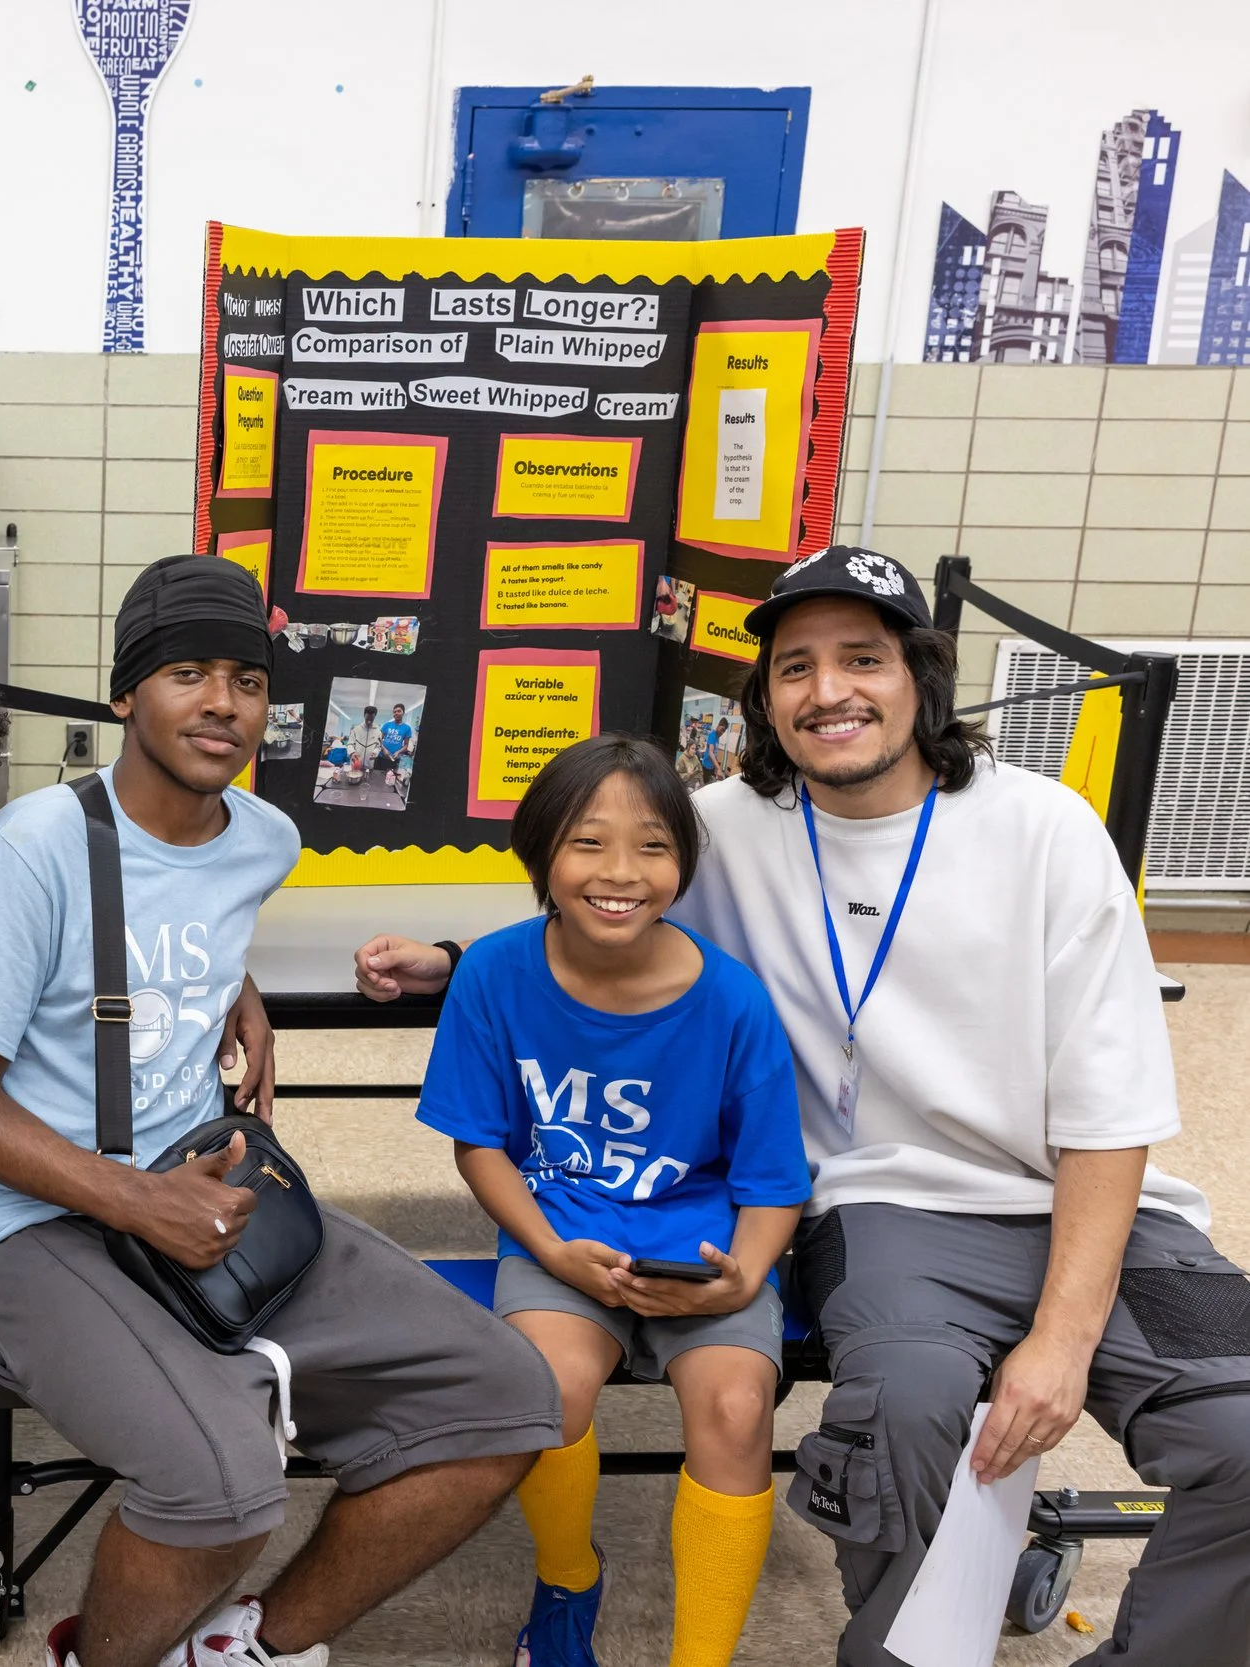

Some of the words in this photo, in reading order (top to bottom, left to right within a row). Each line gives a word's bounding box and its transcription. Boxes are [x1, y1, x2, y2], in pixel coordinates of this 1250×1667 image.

[101, 11, 158, 37] PROTEIN
[101, 38, 158, 56] FRUITS
[132, 58, 156, 70] EAT
[118, 75, 140, 128] WHOLE
[116, 133, 139, 190] GRAINS
[118, 190, 138, 300] HEALTHY
[306, 289, 396, 317] Which
[434, 291, 512, 317] Lasts
[296, 333, 431, 359] Comparison
[438, 334, 462, 354] of
[499, 334, 554, 356] Plain
[562, 336, 661, 363] Whipped
[727, 355, 769, 371] Results
[238, 385, 263, 403] Question
[360, 387, 406, 407] with
[413, 382, 480, 405] Sweet
[487, 386, 586, 414] Whipped
[238, 413, 264, 432] Pregunta
[724, 412, 756, 425] Results
[724, 454, 752, 463] hypothesis
[332, 466, 414, 482] Procedure
[514, 460, 619, 478] Observations
[501, 565, 511, 573] All
[513, 564, 520, 572] of
[522, 563, 540, 571] them
[567, 562, 580, 570] like
[581, 562, 603, 571] candy
[506, 590, 530, 598] tasted
[532, 589, 546, 597] like
[548, 588, 571, 596] dulce
[573, 587, 584, 596] de
[586, 587, 610, 596] leche.
[706, 621, 761, 646] Conclusio
[515, 678, 564, 690] Variable
[505, 691, 536, 701] azúcar
[539, 693, 545, 703] y
[547, 693, 578, 702] vanela
[494, 726, 580, 741] Dependiente:
[505, 745, 529, 754] Nata
[506, 760, 541, 770] tiempo
[848, 902, 881, 917] Won.
[126, 922, 211, 984] MS
[182, 1063, 205, 1082] OF
[516, 1058, 652, 1135] MS
[591, 1140, 691, 1201] 50
